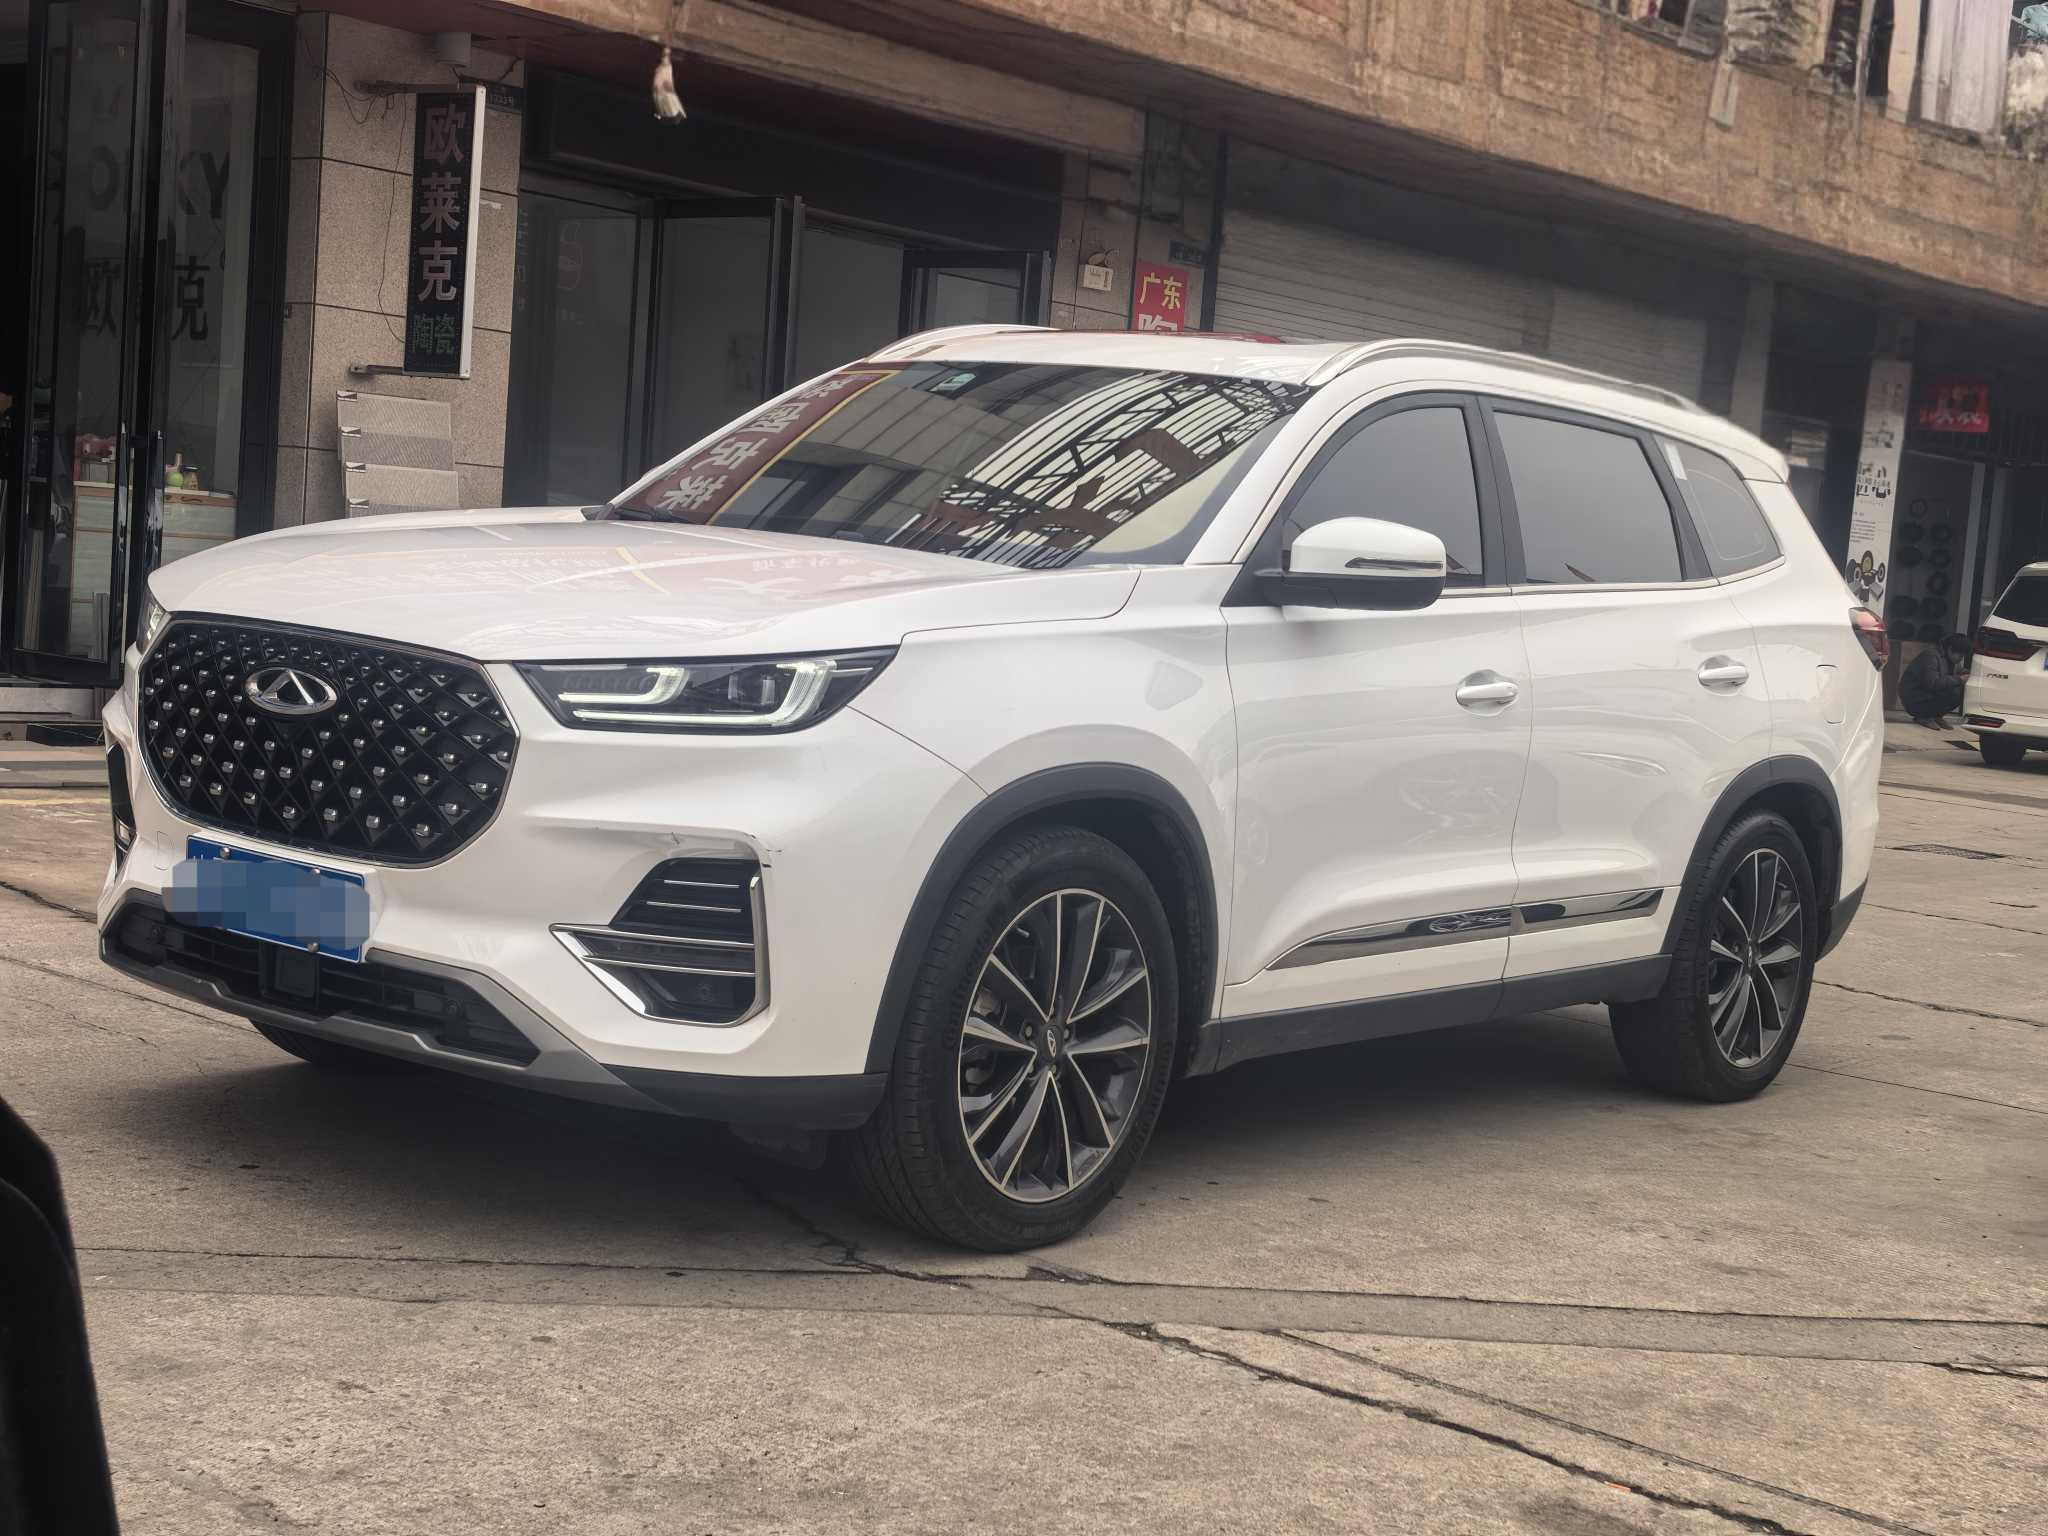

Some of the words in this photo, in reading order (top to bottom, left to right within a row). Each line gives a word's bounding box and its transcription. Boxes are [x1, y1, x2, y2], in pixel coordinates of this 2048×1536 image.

[417, 104, 466, 301] 欧莱克
[1140, 272, 1184, 310] 广东
[412, 312, 457, 354] 陶瓷
